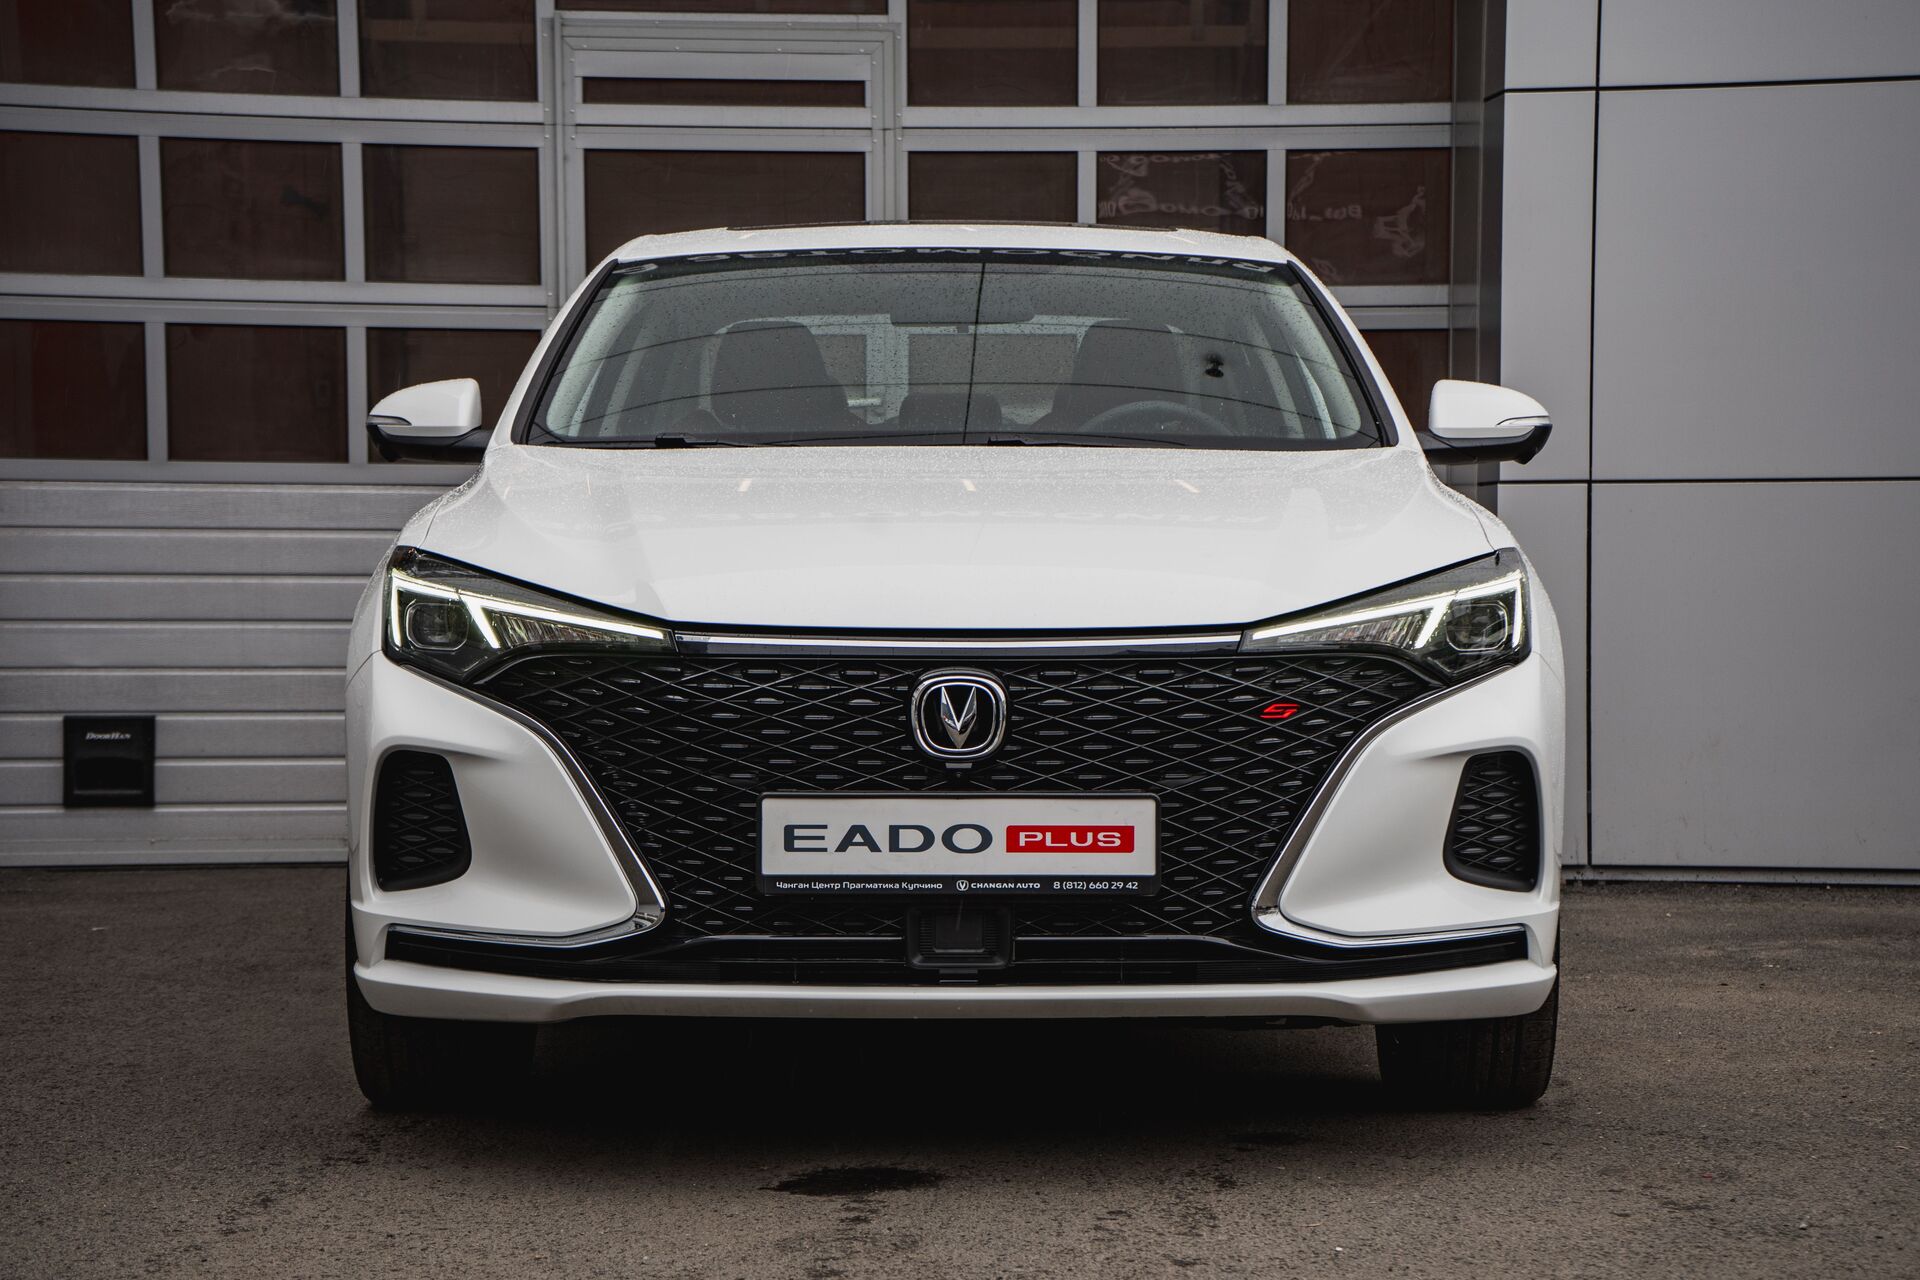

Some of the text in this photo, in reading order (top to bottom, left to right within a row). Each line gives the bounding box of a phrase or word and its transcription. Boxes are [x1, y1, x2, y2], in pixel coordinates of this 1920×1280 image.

[784, 824, 1121, 854] EADO PLUS
[776, 881, 943, 890] Чанган Центр Прагматика Купчино
[1053, 881, 1139, 891] 8 (812) 660 29 42
